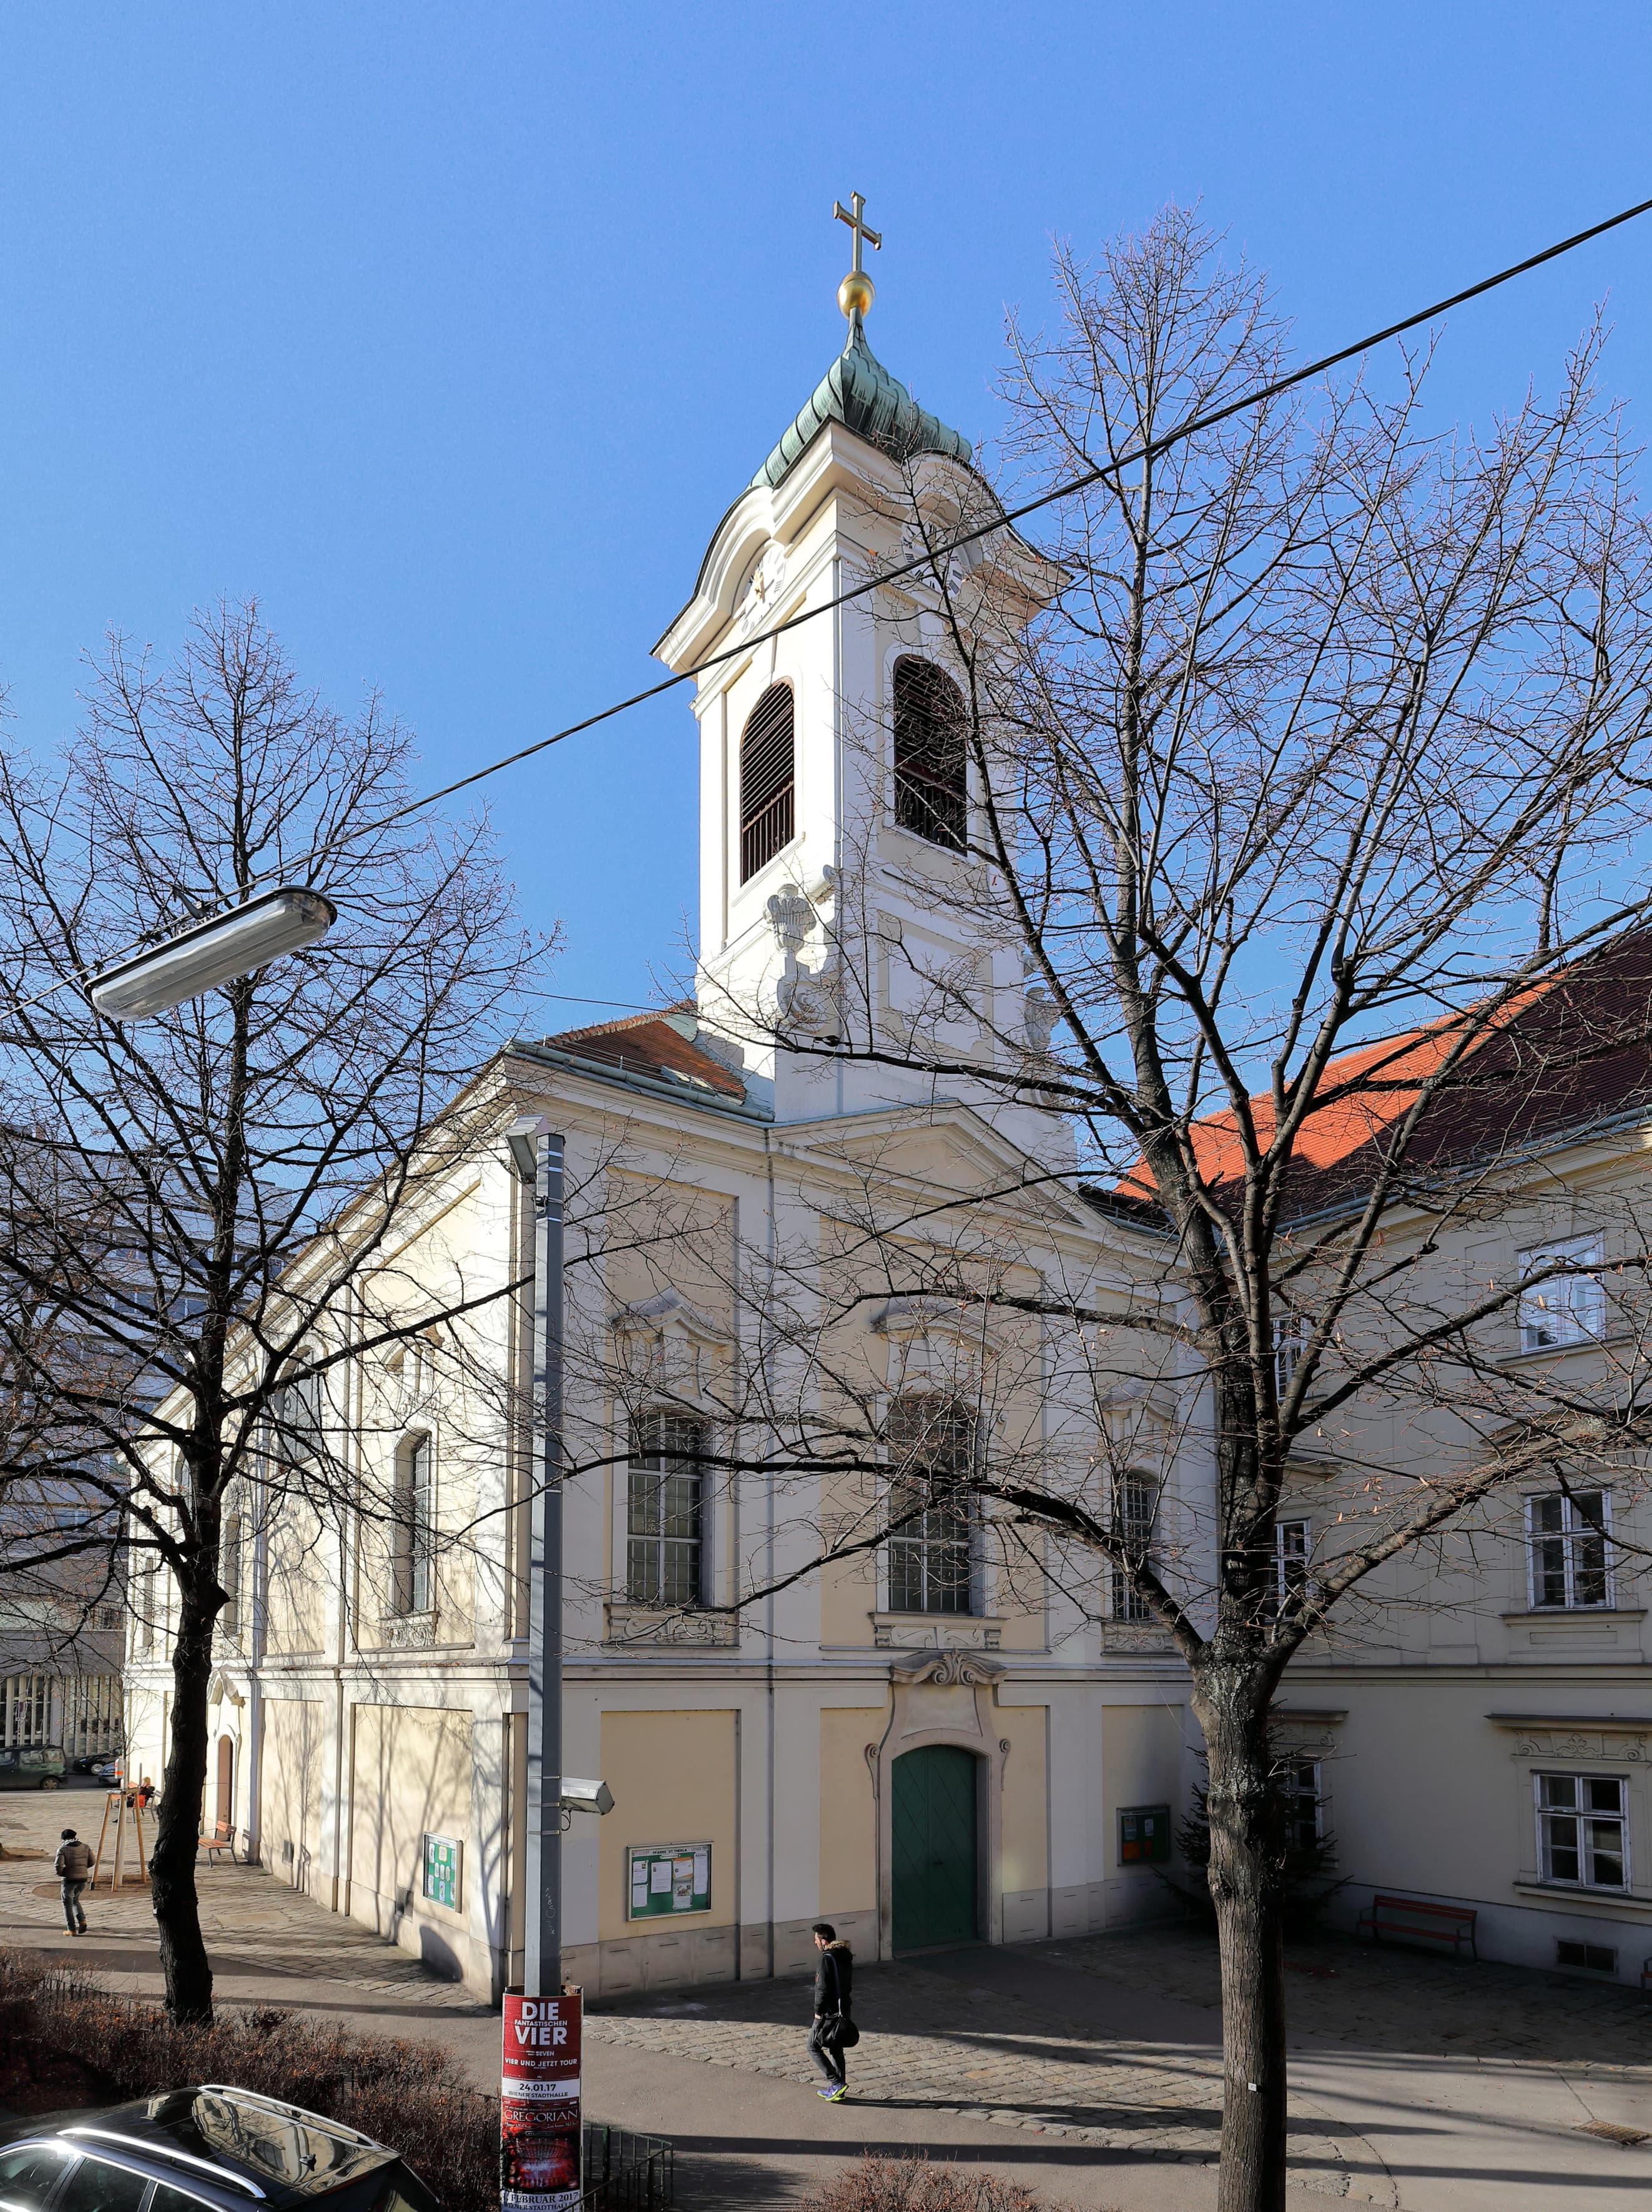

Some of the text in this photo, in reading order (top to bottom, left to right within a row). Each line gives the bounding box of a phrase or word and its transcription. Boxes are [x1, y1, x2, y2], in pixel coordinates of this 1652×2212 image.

[522, 2002, 559, 2020] DIE
[514, 2026, 568, 2045] VIER
[504, 2057, 519, 2066] VIER
[519, 2083, 556, 2092] 24.01.17
[504, 2109, 578, 2122] GREGORIAN
[511, 2192, 578, 2204] FEBRUAR 2017
